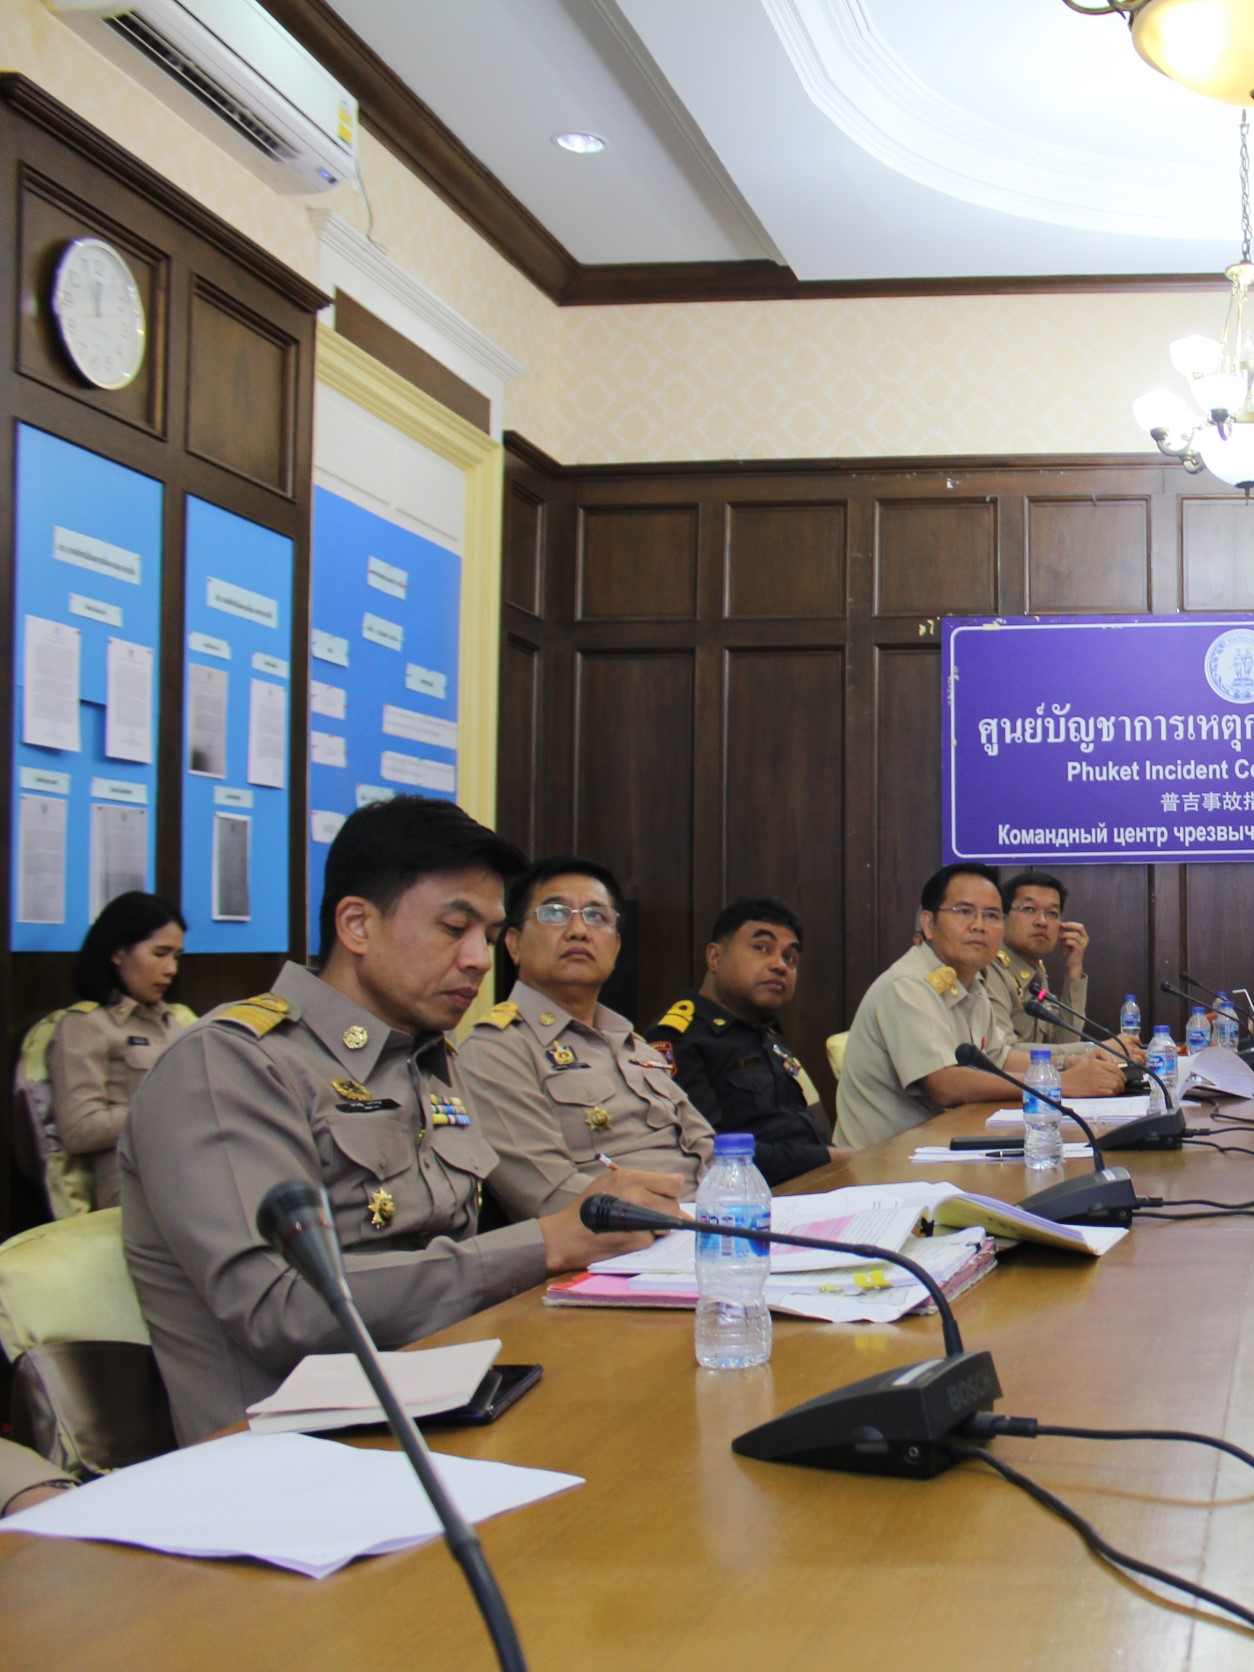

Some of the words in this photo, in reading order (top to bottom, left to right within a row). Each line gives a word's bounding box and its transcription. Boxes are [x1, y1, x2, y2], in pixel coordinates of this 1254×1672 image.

[1067, 761, 1139, 782] Phuket
[1145, 760, 1229, 780] Incident
[998, 822, 1108, 847] Командный
[1113, 826, 1168, 847] центр
[946, 1367, 993, 1412] BOSCH
